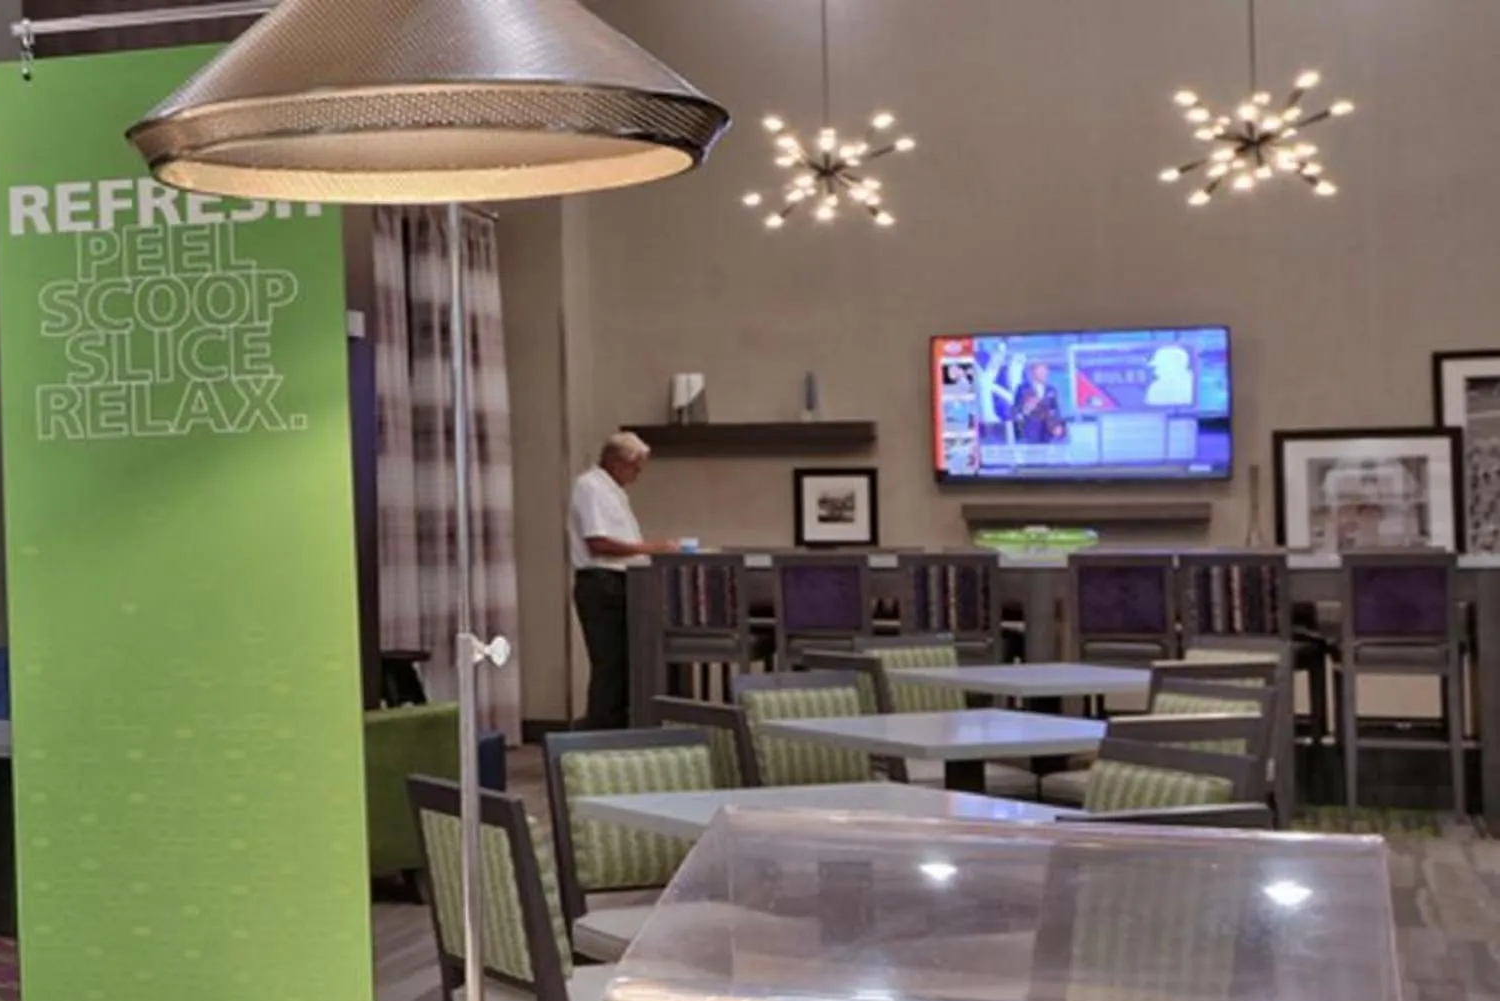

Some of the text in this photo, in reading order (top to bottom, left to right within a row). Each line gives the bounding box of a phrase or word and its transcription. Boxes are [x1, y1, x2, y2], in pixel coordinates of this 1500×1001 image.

[77, 223, 256, 283] PEEL
[38, 270, 298, 337] SCOOP
[65, 325, 274, 386] SLICE
[36, 376, 308, 440] RELAX.
